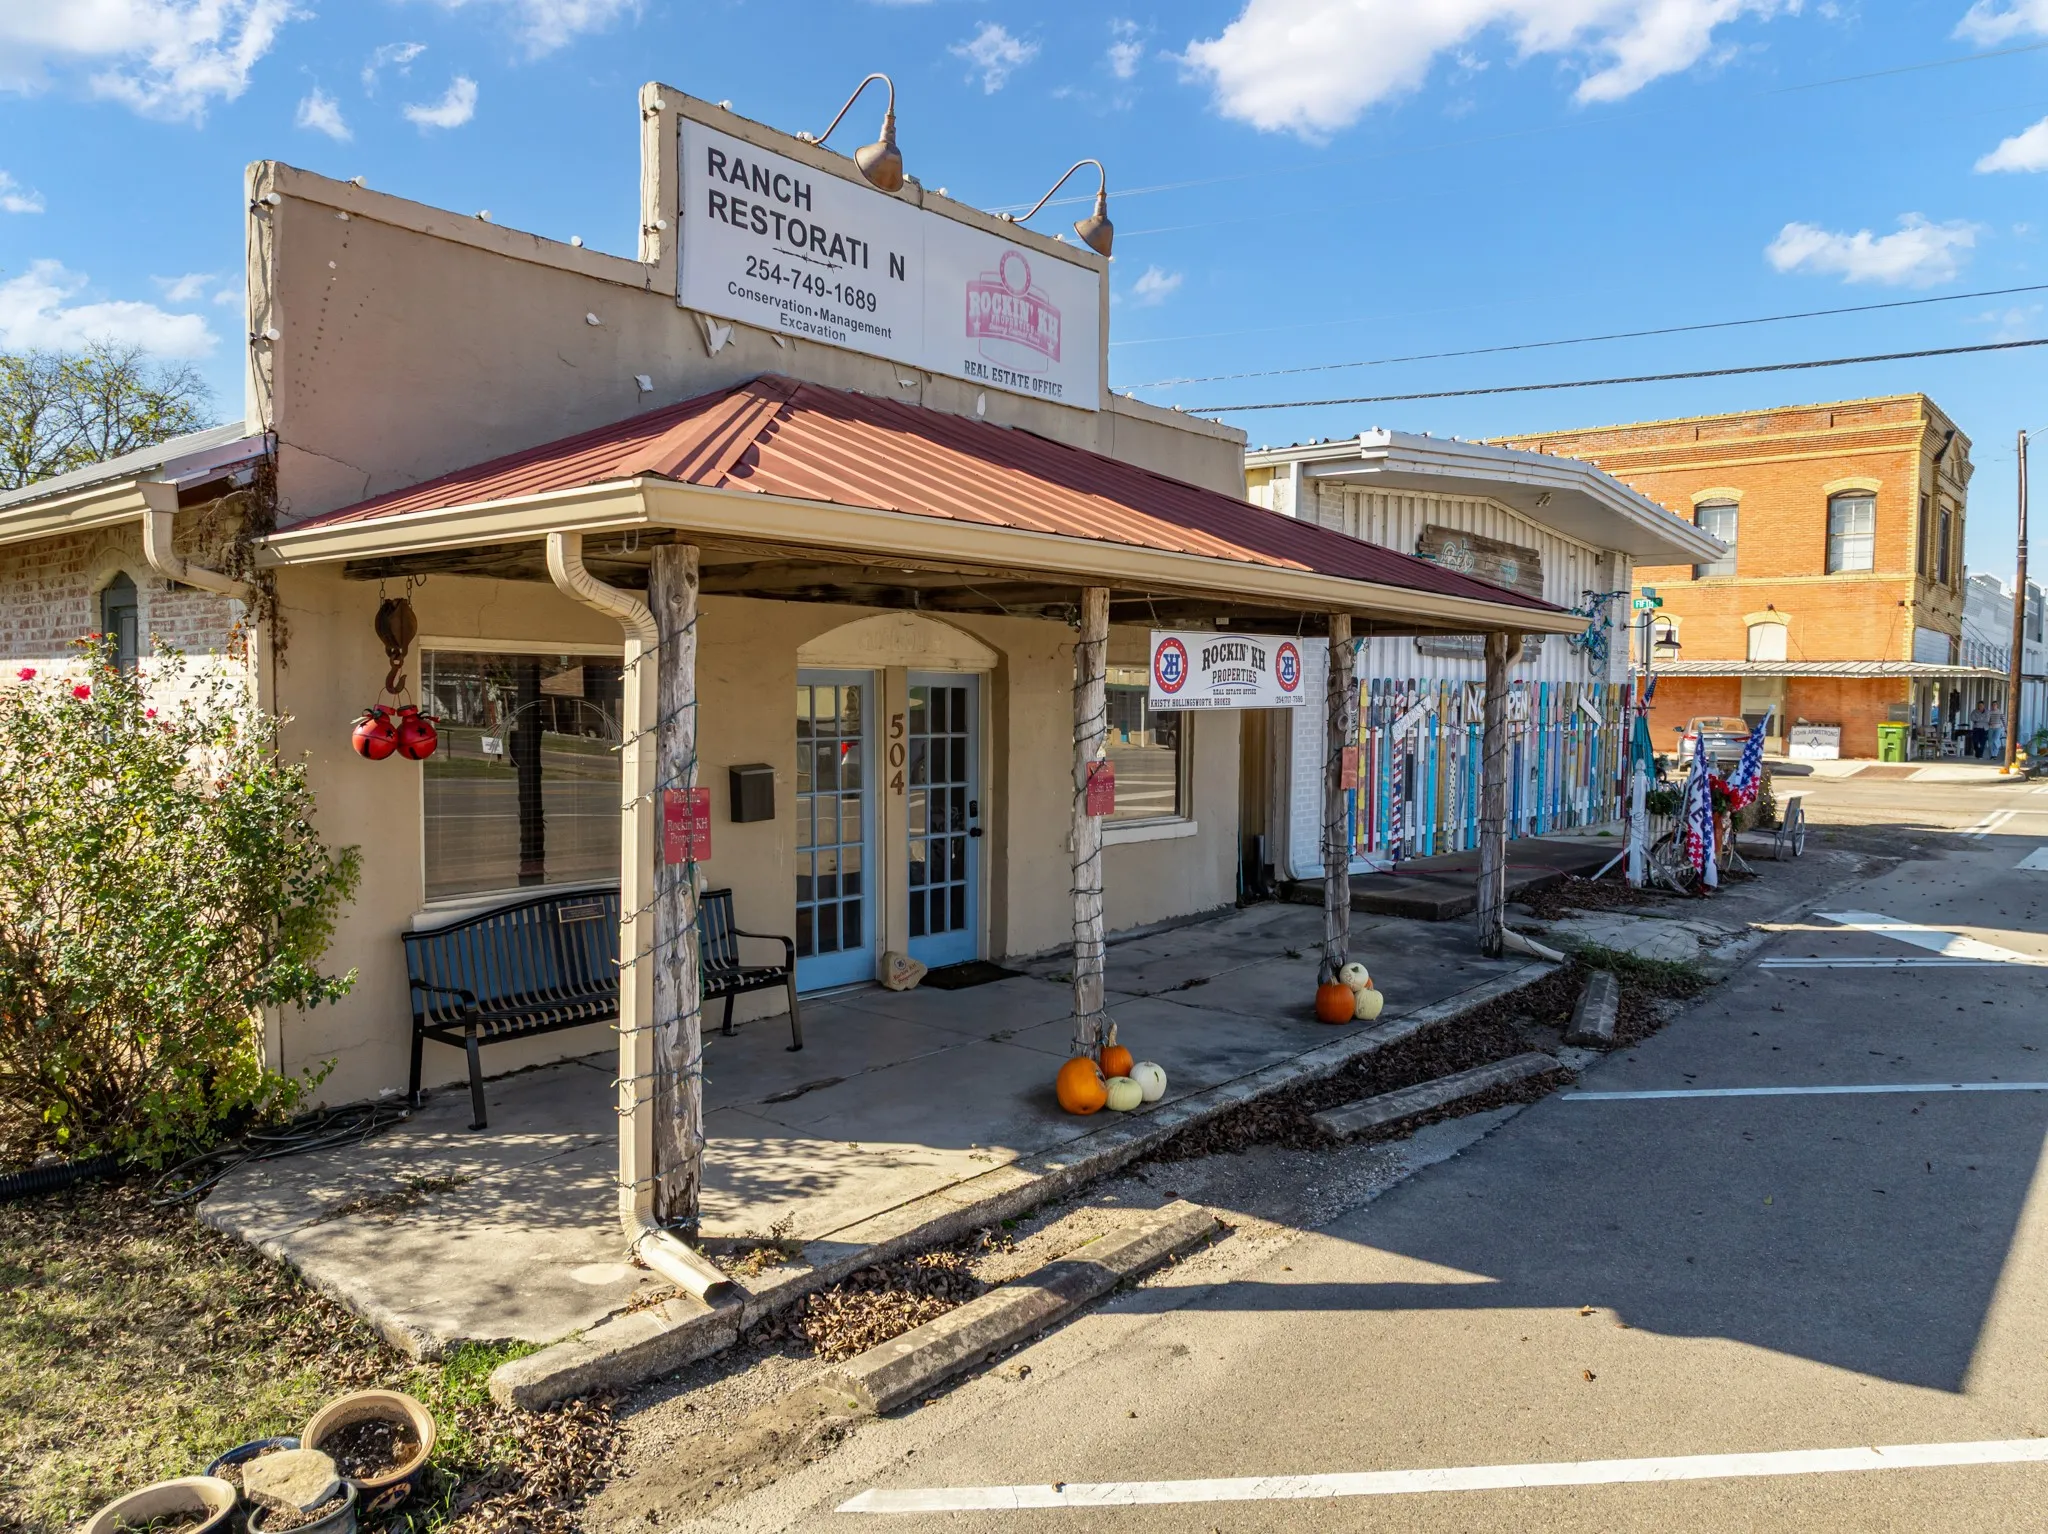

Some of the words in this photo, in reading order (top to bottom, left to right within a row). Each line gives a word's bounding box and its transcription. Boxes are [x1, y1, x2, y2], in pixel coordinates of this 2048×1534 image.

[707, 147, 811, 212] RANCH
[746, 255, 877, 312] 254-749-1689
[780, 312, 846, 342] Excavation
[964, 360, 989, 380] REAL
[992, 367, 1030, 390] ESTATE
[1032, 378, 1063, 398] OFFICE
[1201, 643, 1249, 672] ROCKIN'
[1251, 646, 1266, 672] KH
[1212, 668, 1257, 684] PROPERTIES
[1151, 698, 1171, 708] KRISTY
[1214, 697, 1231, 707] BROKER
[1213, 688, 1224, 696] REAL
[1226, 688, 1242, 696] ESTATE
[1506, 690, 1528, 720] PEN
[889, 713, 905, 795] 504
[673, 791, 701, 806] Paring
[696, 817, 708, 830] KH
[670, 832, 705, 846] Propeties
